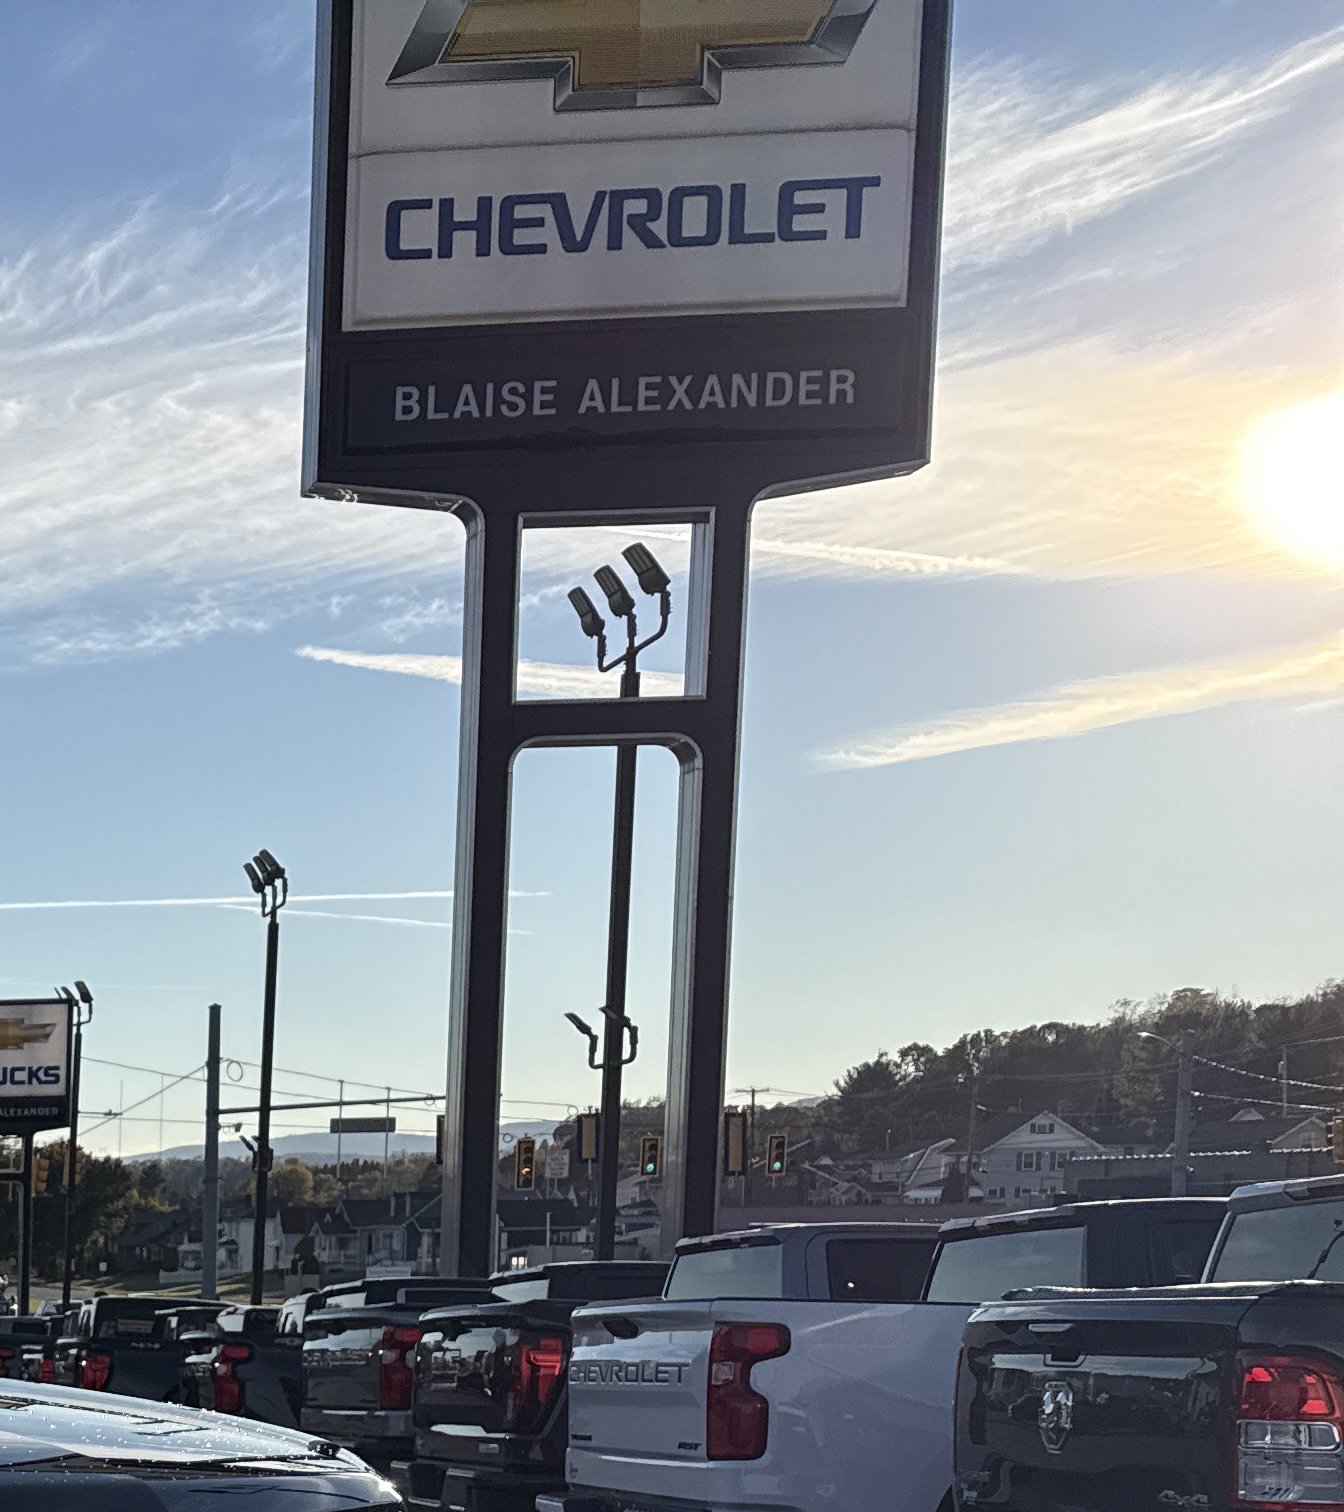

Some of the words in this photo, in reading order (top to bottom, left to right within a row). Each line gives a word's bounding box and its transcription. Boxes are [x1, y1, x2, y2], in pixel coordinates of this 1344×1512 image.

[384, 175, 881, 260] CHEVROLET
[394, 379, 557, 422] BLAISE
[577, 368, 857, 415] ALEXANDER
[568, 1361, 691, 1386] CHEVROLET
